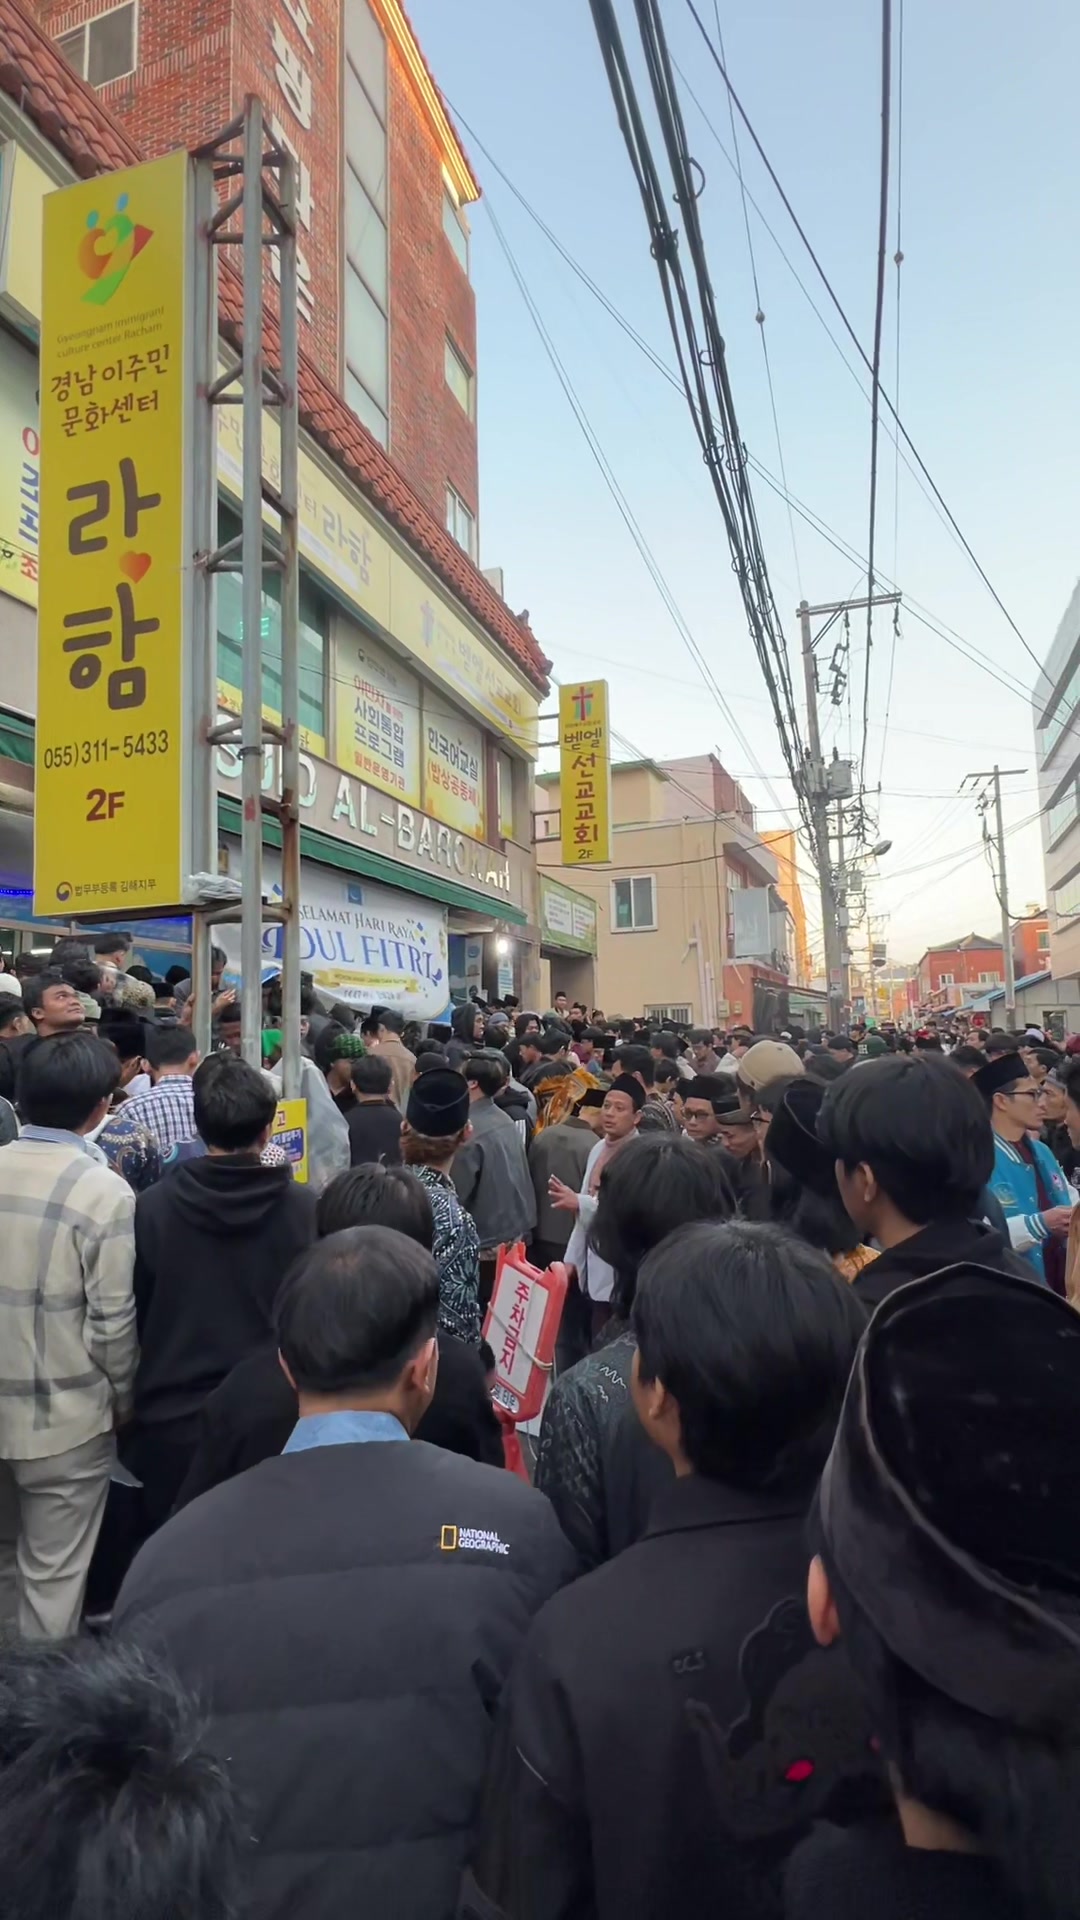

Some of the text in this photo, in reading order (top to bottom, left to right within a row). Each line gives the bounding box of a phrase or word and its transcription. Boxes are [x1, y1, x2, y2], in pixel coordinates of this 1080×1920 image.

[51, 343, 170, 402] 경남 이주민
[61, 390, 158, 438] 문화센터
[322, 504, 372, 588] 라함
[354, 721, 405, 769] 프로그램
[428, 726, 478, 783] 한국어교실
[563, 727, 602, 750] 벧엘
[86, 788, 126, 822] 2F
[571, 752, 599, 845] 선교교회
[578, 848, 594, 860] 2F
[355, 912, 385, 933] HARI
[388, 923, 416, 942] RAYA
[361, 934, 443, 987] FITRI
[500, 1281, 530, 1376] 주차금지
[458, 1537, 510, 1555] GEOGRAPHIC
[459, 1527, 500, 1542] NATIONAL
